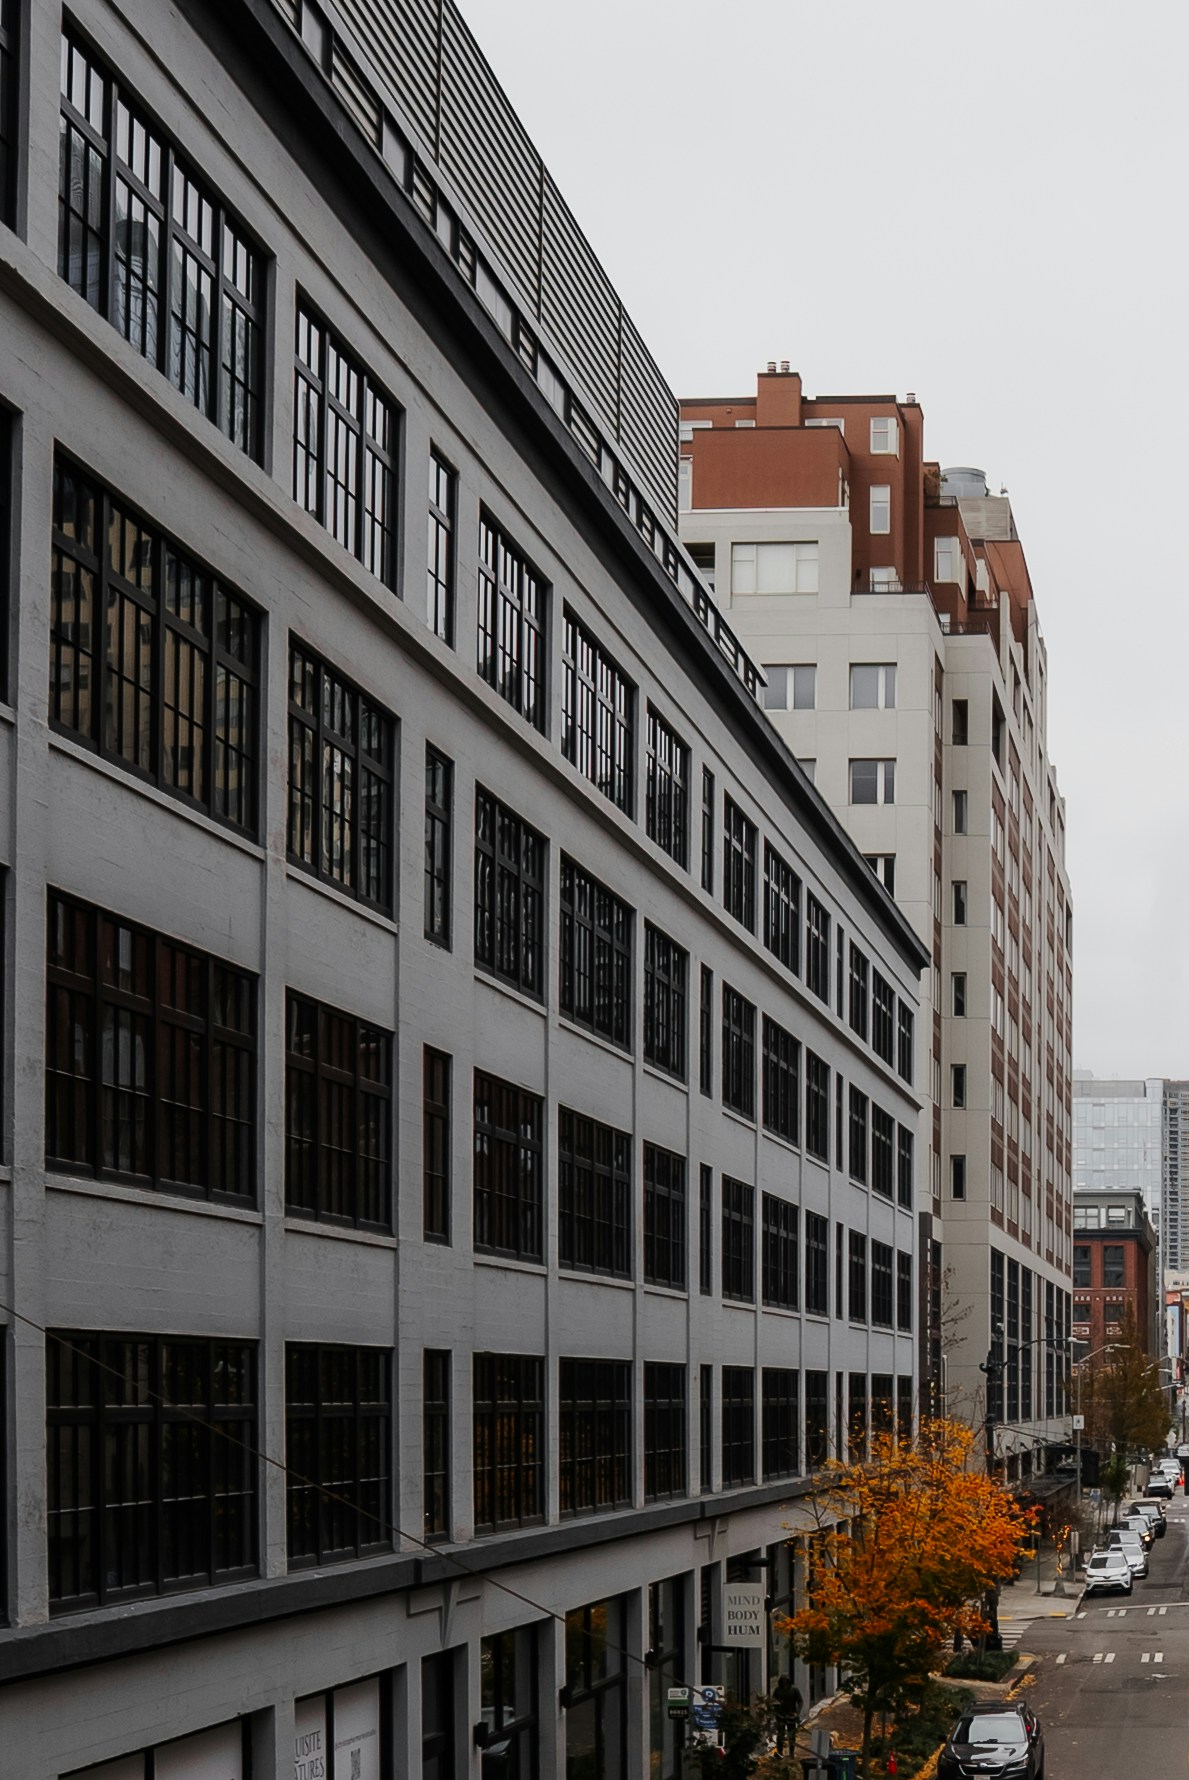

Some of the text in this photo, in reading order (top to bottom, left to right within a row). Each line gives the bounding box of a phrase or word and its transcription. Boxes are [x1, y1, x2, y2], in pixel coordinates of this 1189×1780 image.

[727, 1595, 760, 1606] MIND
[727, 1610, 760, 1621] BODY
[727, 1625, 761, 1636] HUM
[294, 1729, 322, 1759] UISITE
